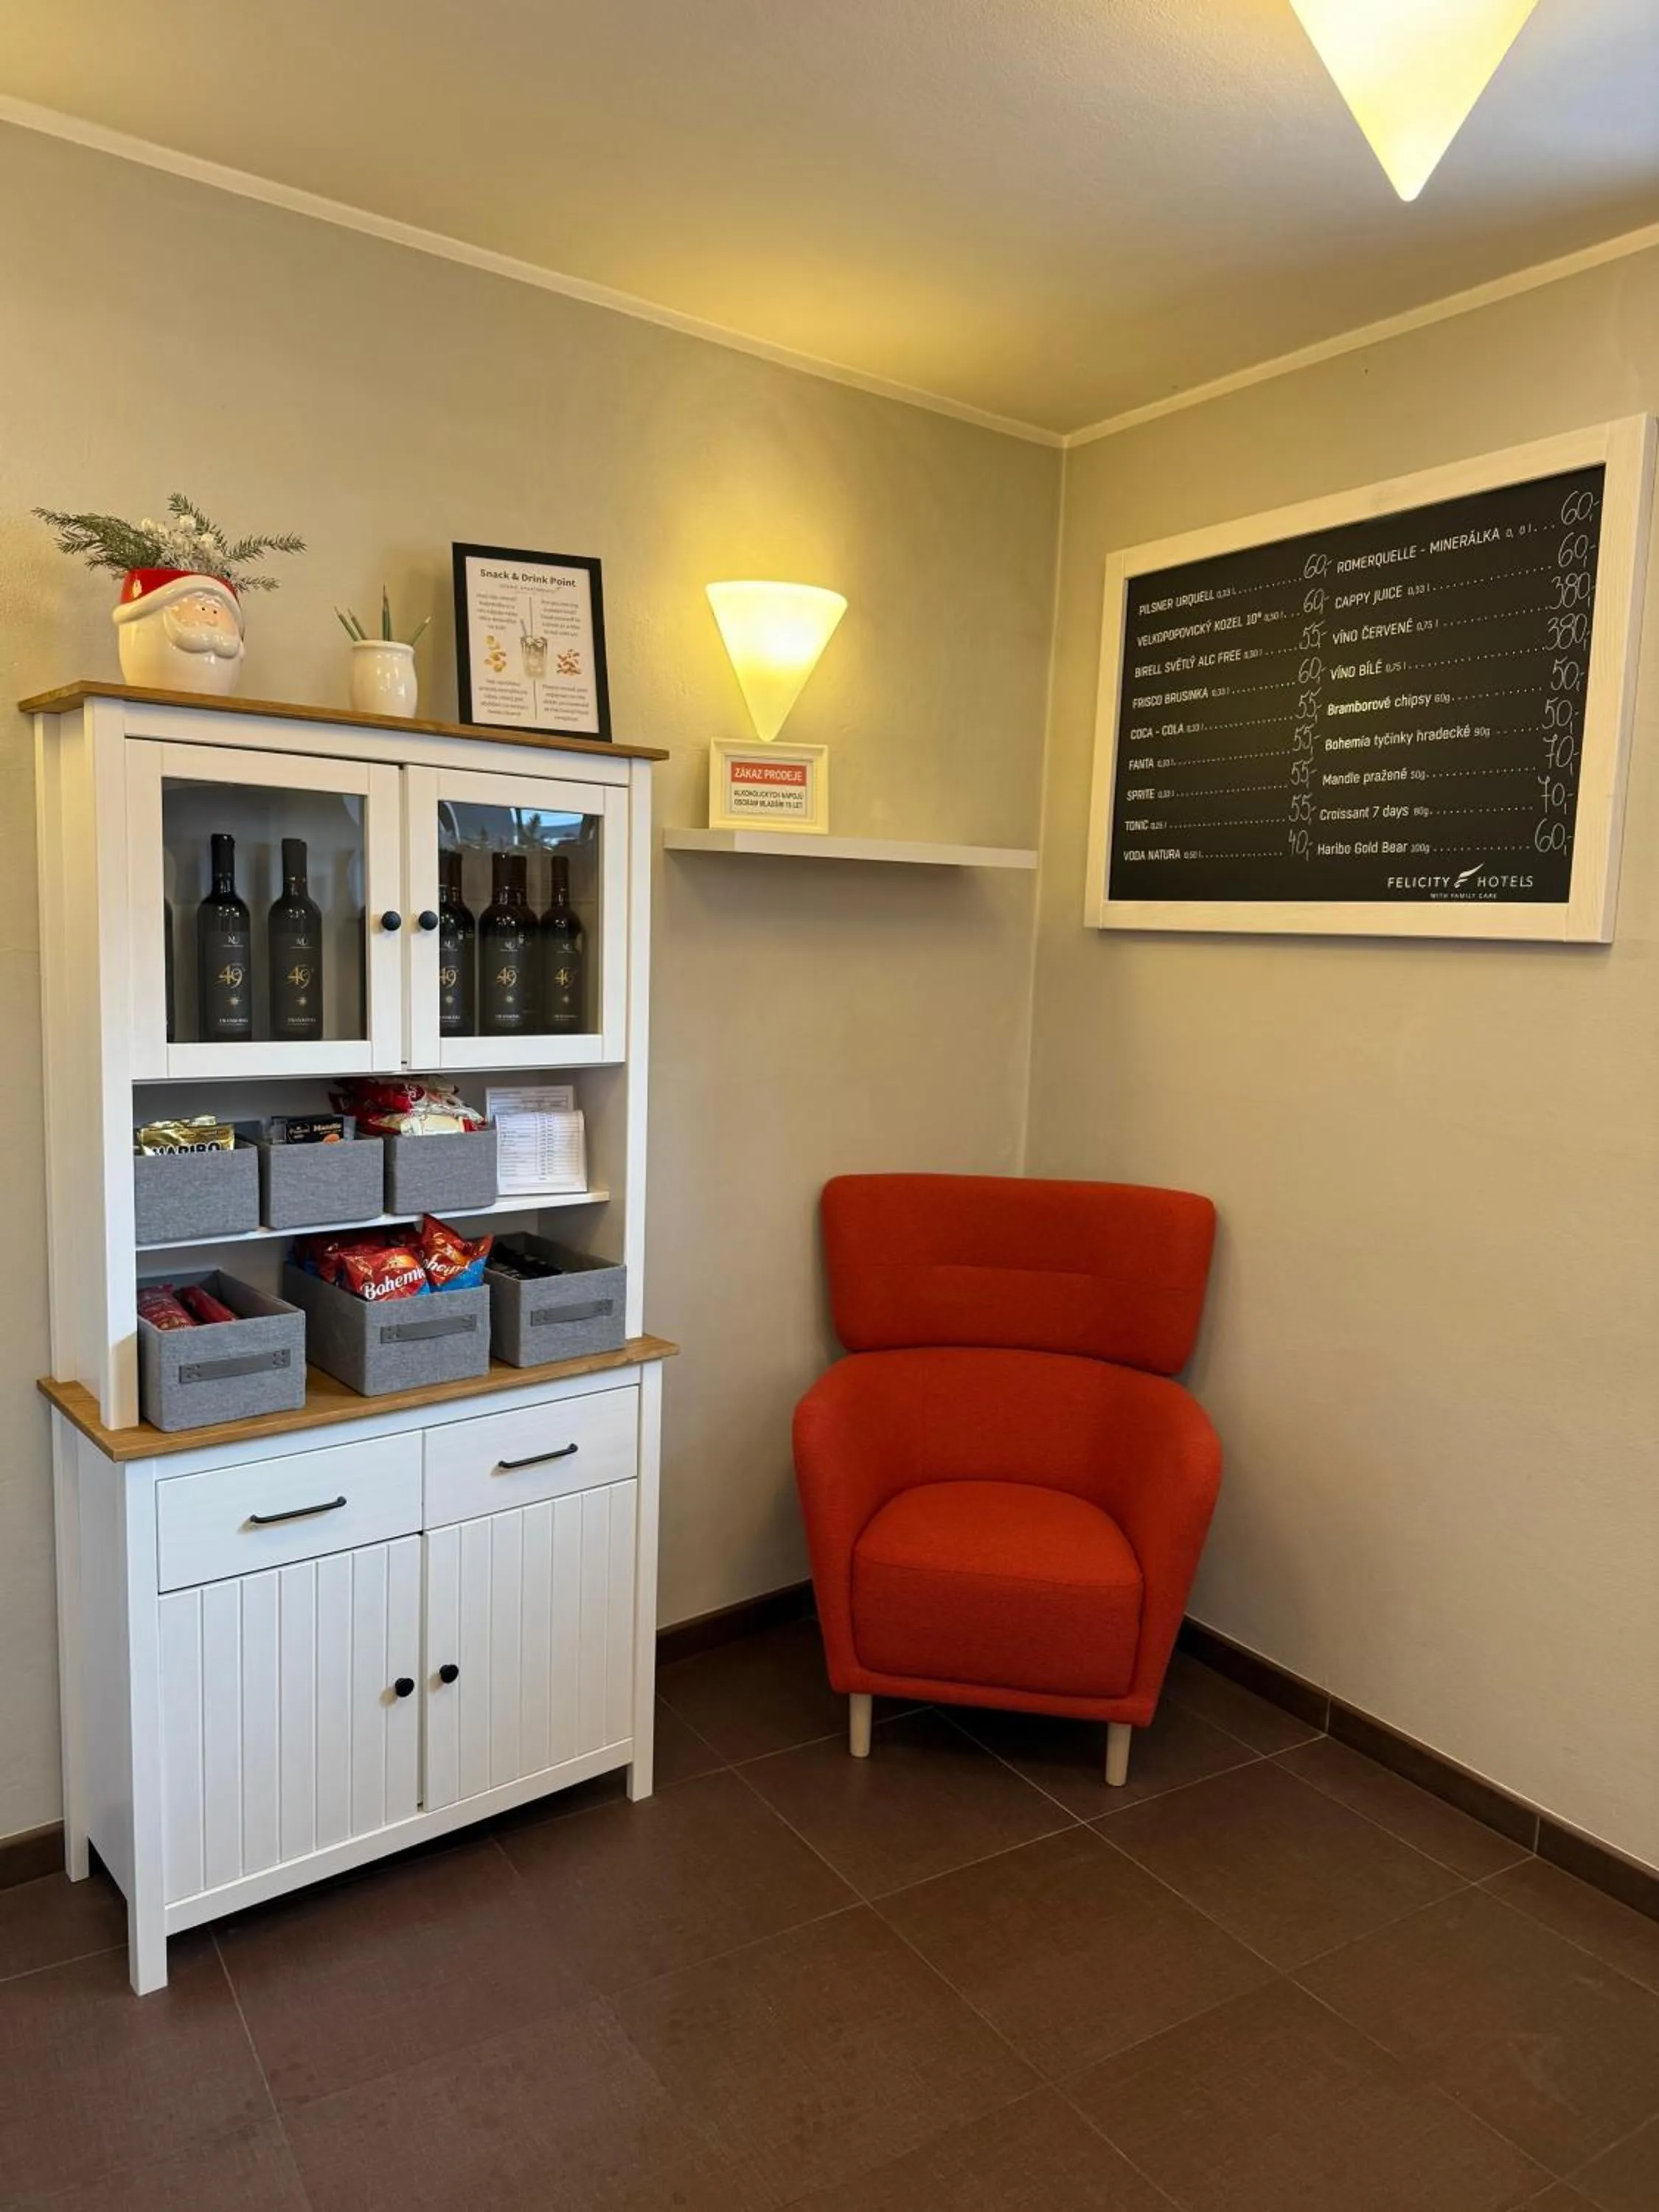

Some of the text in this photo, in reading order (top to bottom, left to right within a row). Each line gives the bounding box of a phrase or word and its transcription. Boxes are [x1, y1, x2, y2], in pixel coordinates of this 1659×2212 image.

[1337, 545, 1417, 574] ROMERQUELLE
[1430, 527, 1500, 554] MINERÁLKA
[480, 568, 577, 588] Snack & Drink Point
[1139, 598, 1173, 616] PILSNER
[1176, 590, 1214, 607] URQUELL
[1335, 591, 1371, 610] CAPPY
[1372, 585, 1403, 605] JUICE
[1136, 619, 1212, 647] VELKOPOPOVICKÝ
[1214, 616, 1242, 631] KOZEL
[1332, 629, 1358, 645] VÍNO
[1362, 617, 1413, 640] ČERVENÉ
[1135, 664, 1162, 678] BIRELL
[1164, 655, 1195, 673] SVĚTLÝ
[1198, 653, 1216, 666] ALC
[1218, 649, 1242, 663] FREE
[1330, 664, 1355, 681] VÍNO
[1359, 658, 1382, 677] BÍLÉ
[1132, 694, 1162, 709] FRISCO
[1164, 687, 1208, 704] BRUSINKA
[1327, 695, 1391, 716] Bramborové
[1394, 694, 1433, 708] chipsy
[1130, 727, 1153, 740] COCA
[1161, 723, 1183, 737] COLA
[1325, 735, 1371, 751] Bohemia
[1374, 731, 1413, 749] tyčinky
[1416, 723, 1471, 742] hradecké
[1129, 757, 1154, 771] FANTA
[735, 767, 803, 782] ZÁKAZ PRODEJE
[1322, 771, 1360, 786] Mandle
[1363, 768, 1408, 785] pražené
[1127, 788, 1155, 801] SPRITE
[1320, 807, 1369, 821] Croissant
[1372, 806, 1380, 818] 7
[1382, 804, 1410, 818] days
[1124, 819, 1149, 831] TONIC
[1124, 849, 1145, 861] VODA
[1147, 849, 1180, 860] NATURA
[1318, 843, 1351, 855] Haribo
[1354, 841, 1378, 855] Gold
[1382, 841, 1408, 853] Bear
[1387, 875, 1534, 889] FELICITY HOTELS
